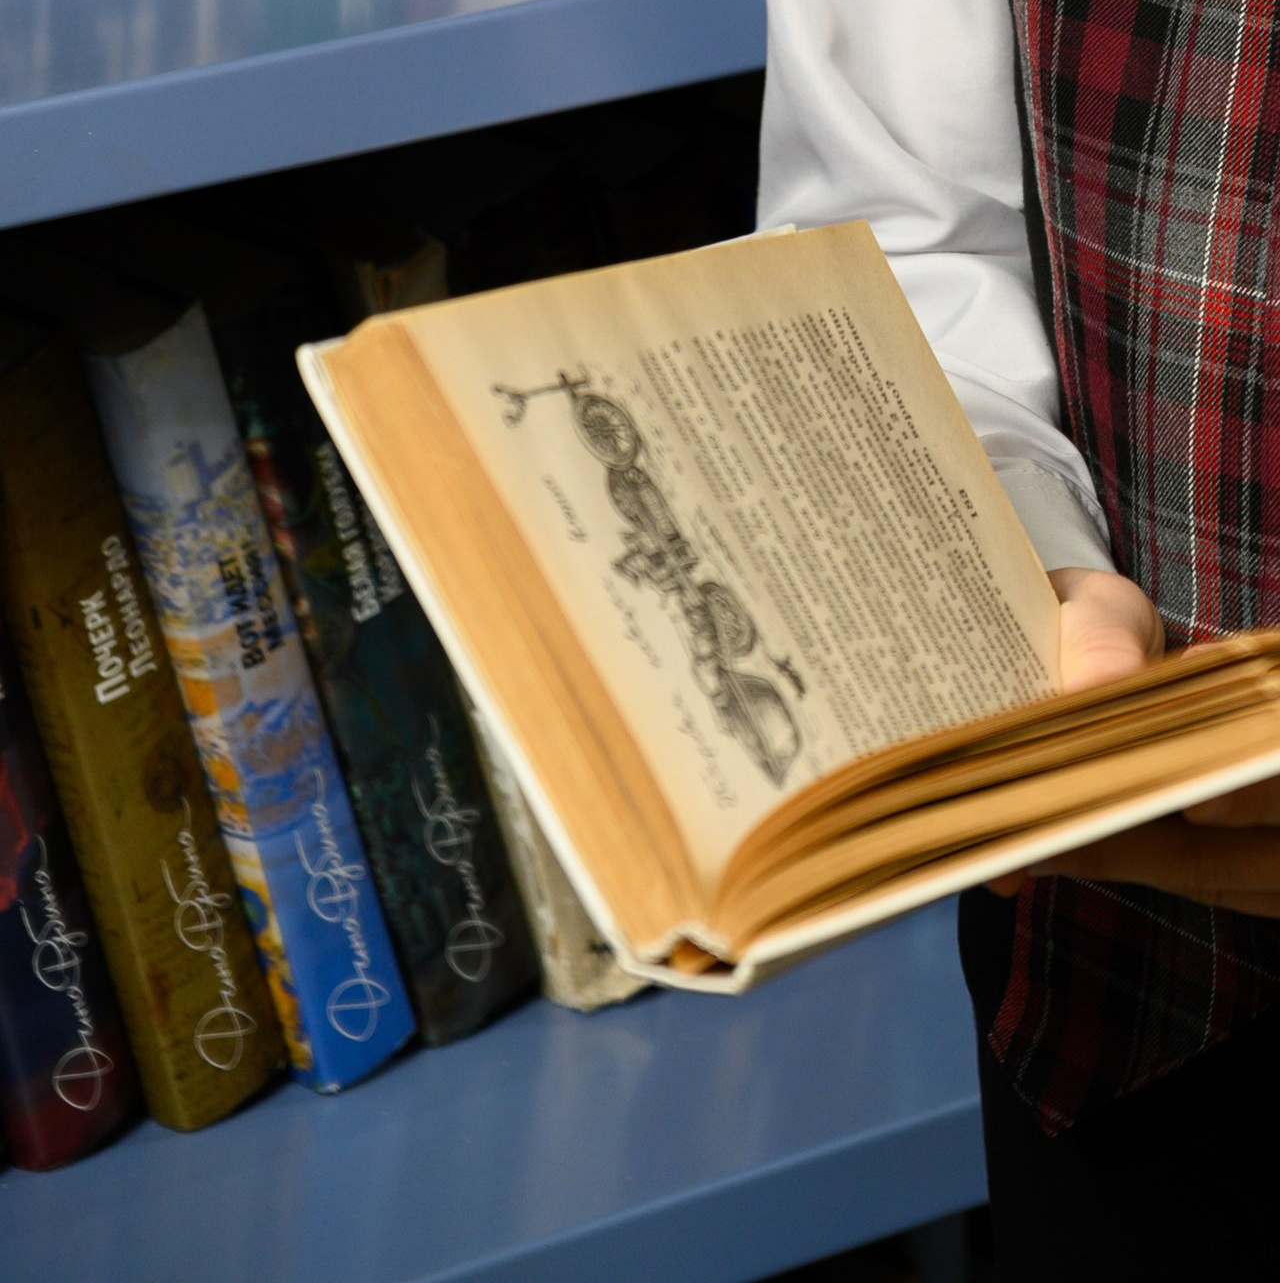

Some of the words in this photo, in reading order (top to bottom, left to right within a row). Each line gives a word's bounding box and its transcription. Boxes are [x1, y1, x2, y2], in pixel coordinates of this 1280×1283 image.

[883, 377, 924, 440] верно?
[80, 590, 132, 705] ПОЧЕРК
[101, 535, 158, 681] ЛЕОНАРДО
